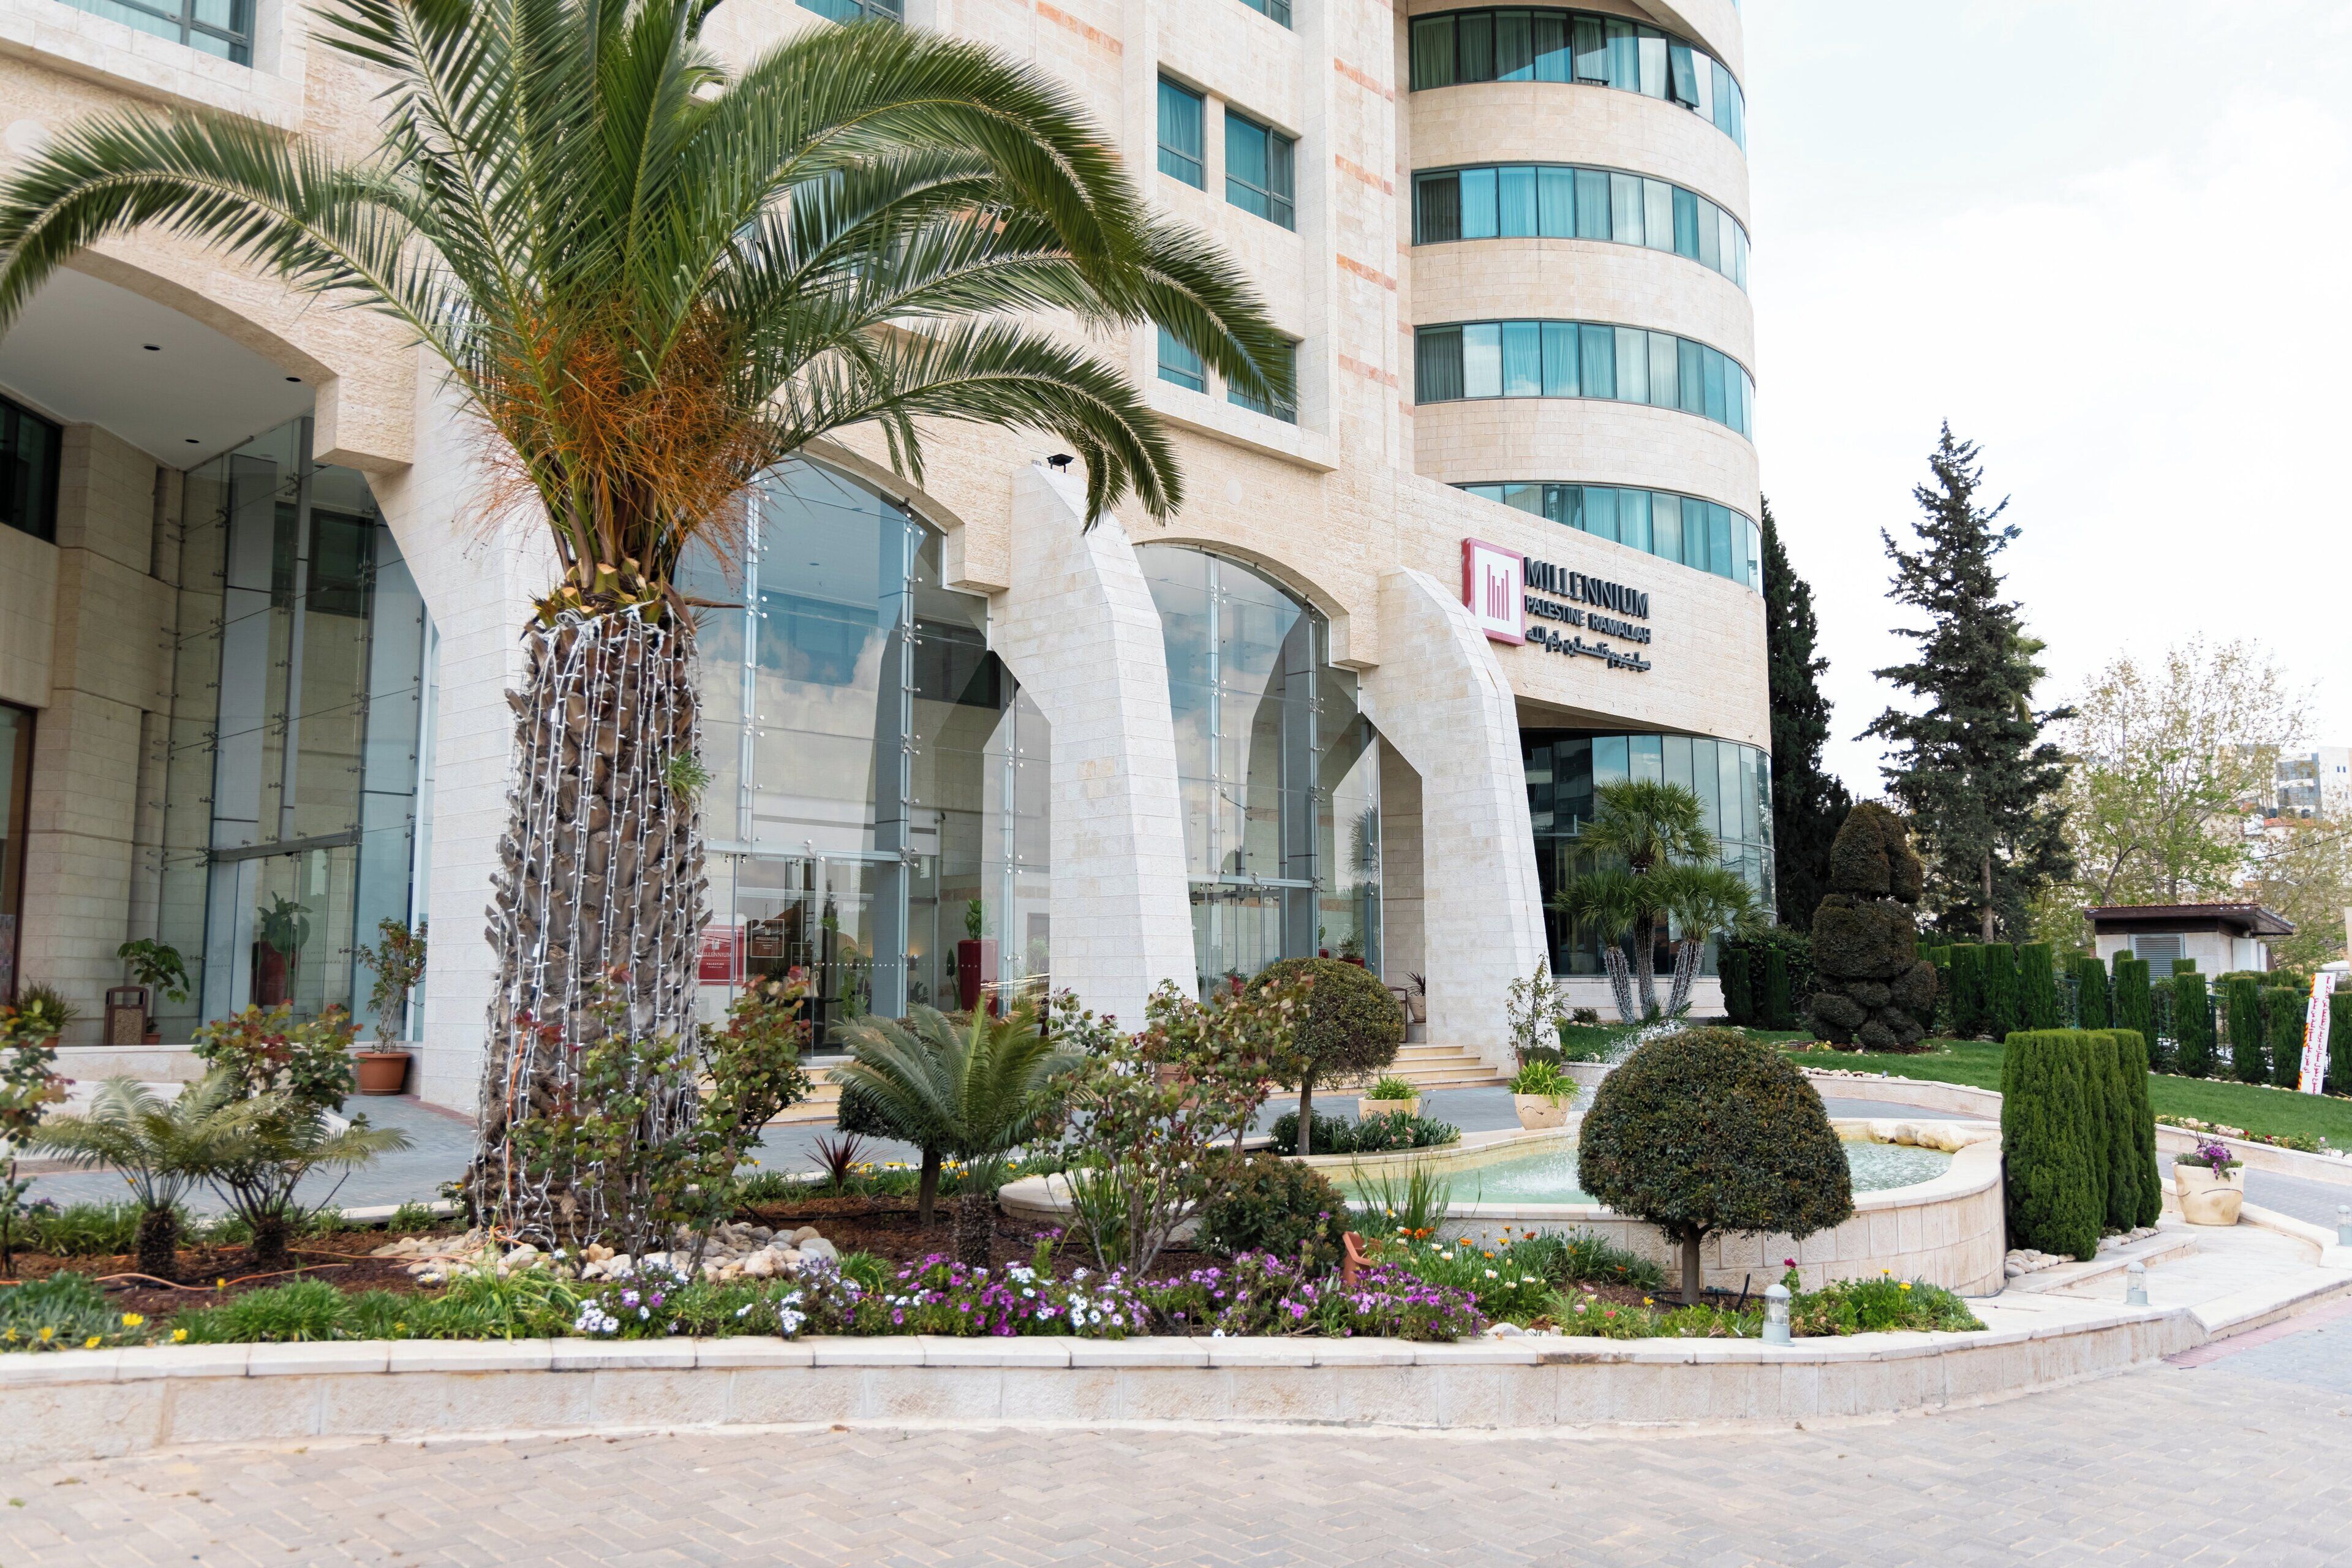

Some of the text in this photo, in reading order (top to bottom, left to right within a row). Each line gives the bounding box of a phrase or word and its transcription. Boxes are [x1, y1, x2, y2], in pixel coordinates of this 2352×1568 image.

[1524, 557, 1649, 619] MILLENNIUM
[1525, 595, 1651, 644] PALESTINE RAMALLAH
[1525, 625, 1547, 644] الله
[1546, 630, 1562, 652] رام
[1563, 635, 1610, 657] فلسطين
